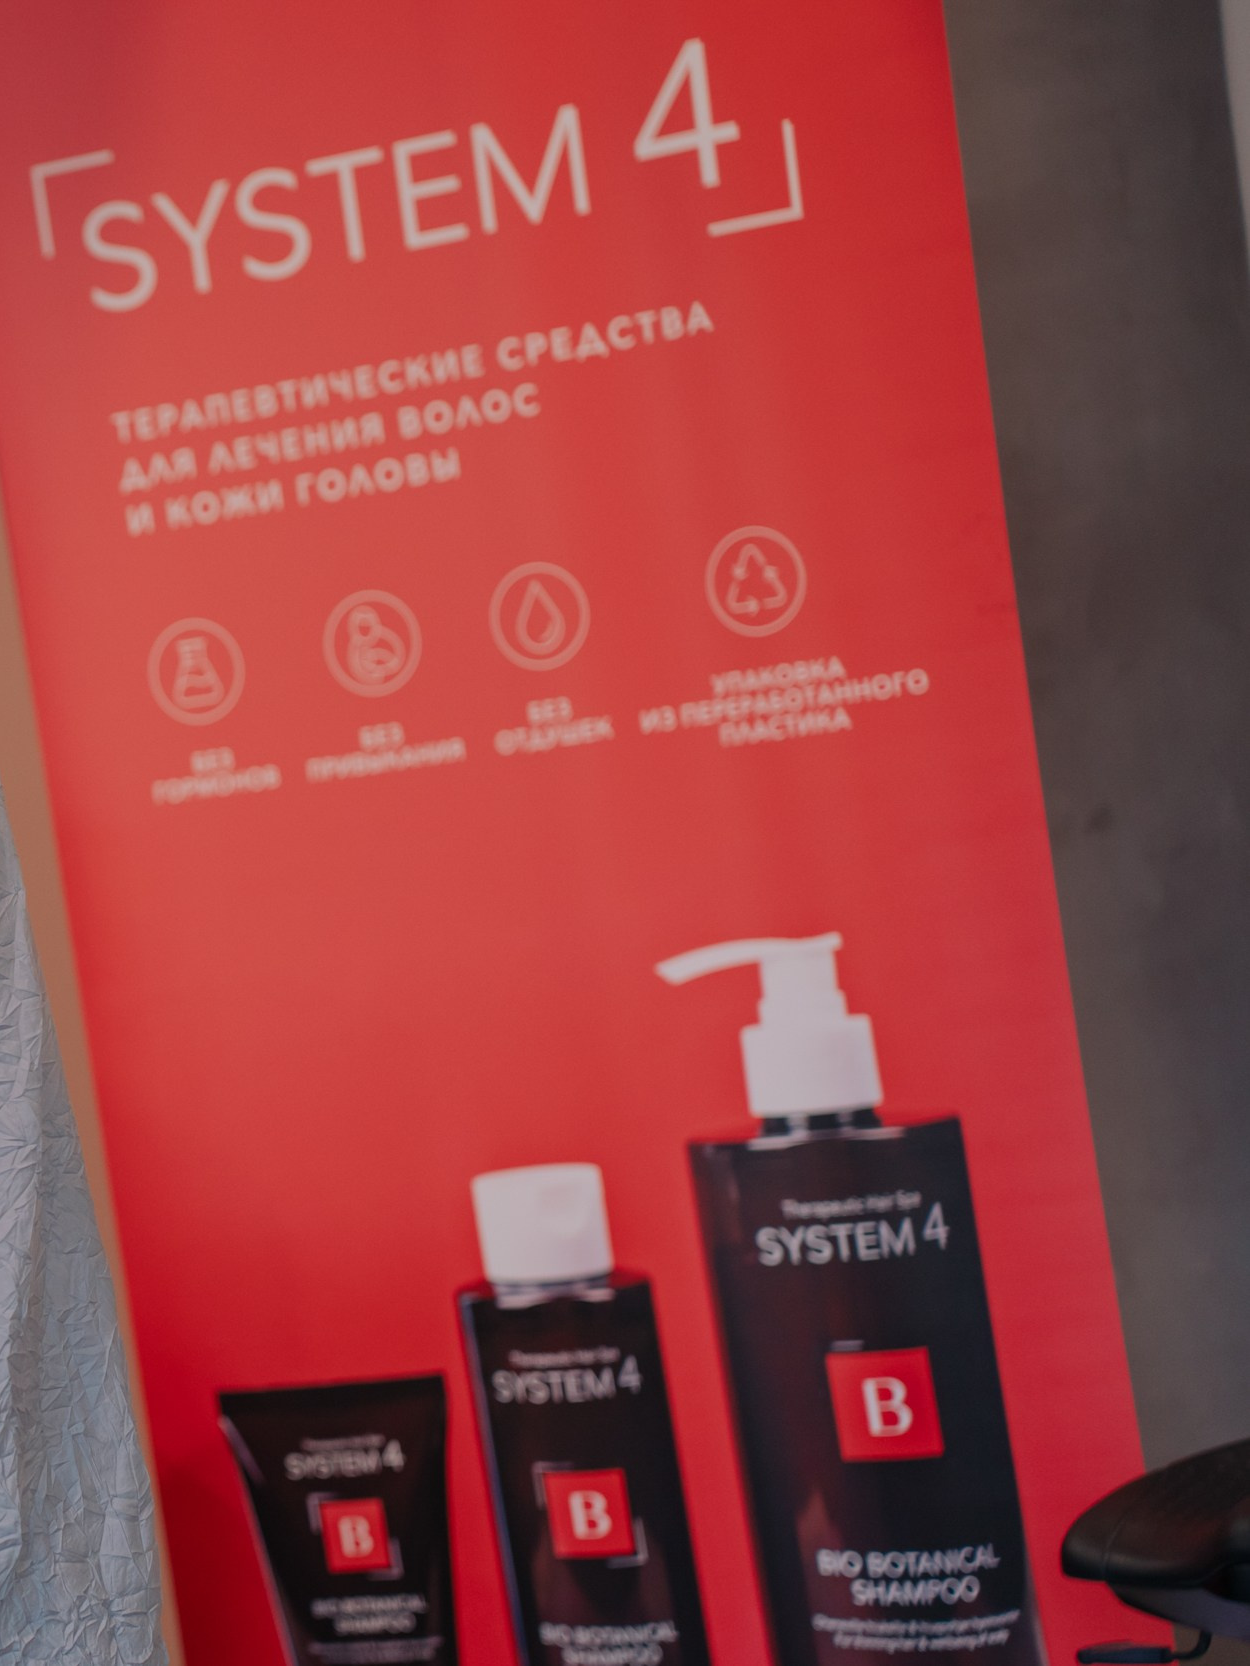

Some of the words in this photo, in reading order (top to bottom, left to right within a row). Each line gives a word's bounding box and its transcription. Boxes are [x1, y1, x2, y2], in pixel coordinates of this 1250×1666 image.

[82, 104, 590, 312] SYSTEM
[633, 37, 740, 189] 4
[110, 343, 486, 444] ТЕРАПЕВТИЧЕСКИЕ
[496, 300, 715, 373] СРЕДСТВА
[119, 447, 197, 494] ДЛЯ
[208, 411, 386, 475] ЛЕЧЕНИЯ
[397, 381, 542, 441] ВОЛОС
[125, 502, 155, 538] И
[165, 478, 285, 531] КОЖИ
[295, 446, 462, 503] ГОЛОВЫ
[710, 656, 847, 697] УПАКОВКА
[526, 696, 573, 726] БЕЗ
[638, 705, 677, 735] ИЗ
[680, 668, 930, 728] ПЕРЕРАБОТАННОГО
[719, 707, 852, 748] ПЛАСТИКА
[755, 1216, 916, 1267] SYSTEM
[922, 1201, 950, 1250] 4
[492, 1366, 616, 1404] SYSTEM
[618, 1355, 643, 1394] 4
[862, 1376, 913, 1438] B
[382, 1439, 406, 1473] 4
[337, 1515, 374, 1557] B
[567, 1490, 612, 1540] B
[816, 1548, 863, 1578] BIO
[865, 1543, 1001, 1579] BOTANICAL
[851, 1575, 981, 1606] SHAMPOO
